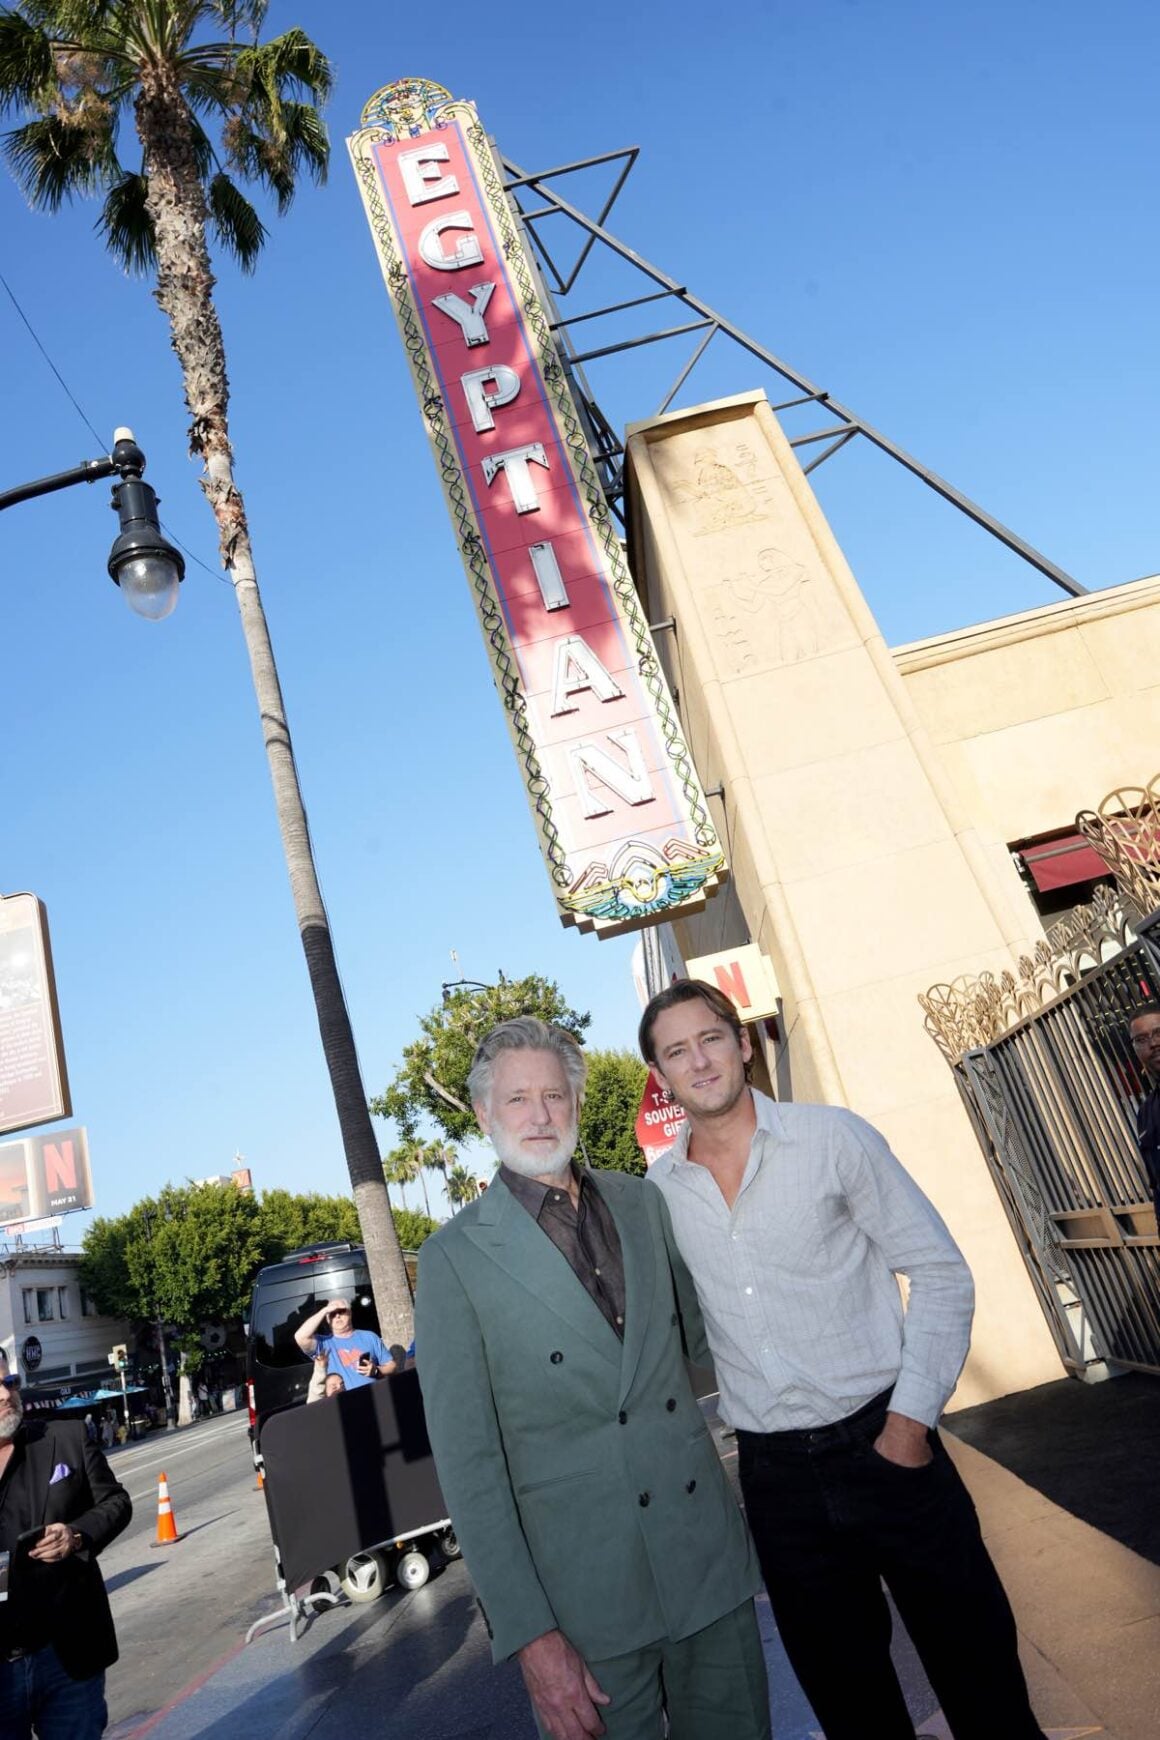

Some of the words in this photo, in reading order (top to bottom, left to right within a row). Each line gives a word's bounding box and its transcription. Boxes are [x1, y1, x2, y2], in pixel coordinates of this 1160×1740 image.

[397, 142, 657, 820] EGYPTIAN
[713, 961, 752, 1008] N
[663, 1117, 687, 1137] GIF
[43, 1139, 77, 1193] N
[50, 1197, 67, 1207] MAY
